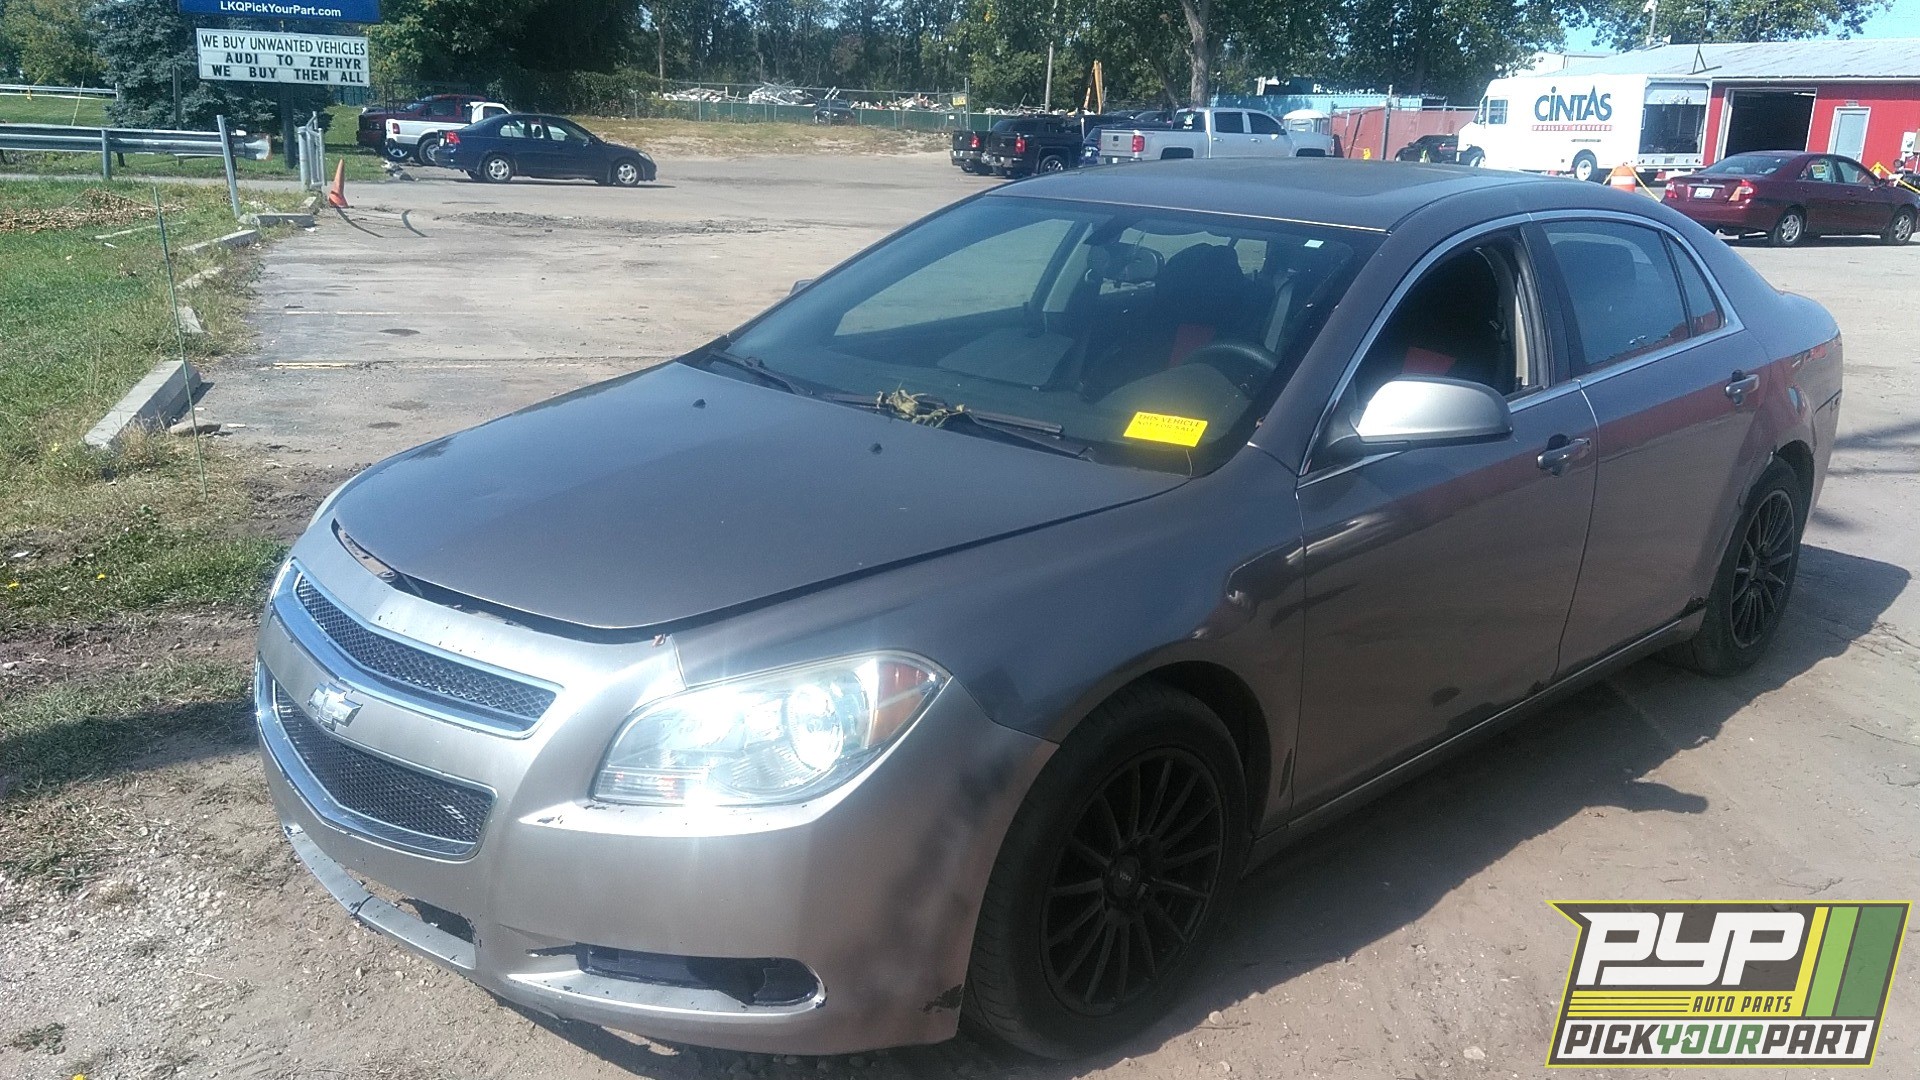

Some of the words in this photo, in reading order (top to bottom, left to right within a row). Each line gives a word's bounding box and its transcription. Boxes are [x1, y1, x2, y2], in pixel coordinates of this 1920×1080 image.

[220, 1, 342, 17] LKQPickYourPart.com
[201, 35, 219, 48] WE
[223, 36, 246, 49] BUY
[249, 38, 314, 53] UNWANTED
[316, 40, 365, 56] VEHICLES
[225, 53, 258, 65] AUDI
[276, 55, 294, 66] TO
[310, 56, 362, 70] ZEPHYR
[211, 65, 231, 77] WE
[249, 67, 277, 79] BUY
[294, 69, 330, 81] THEM
[340, 72, 364, 83] ALL
[1162, 417, 1200, 427] VEHICLE
